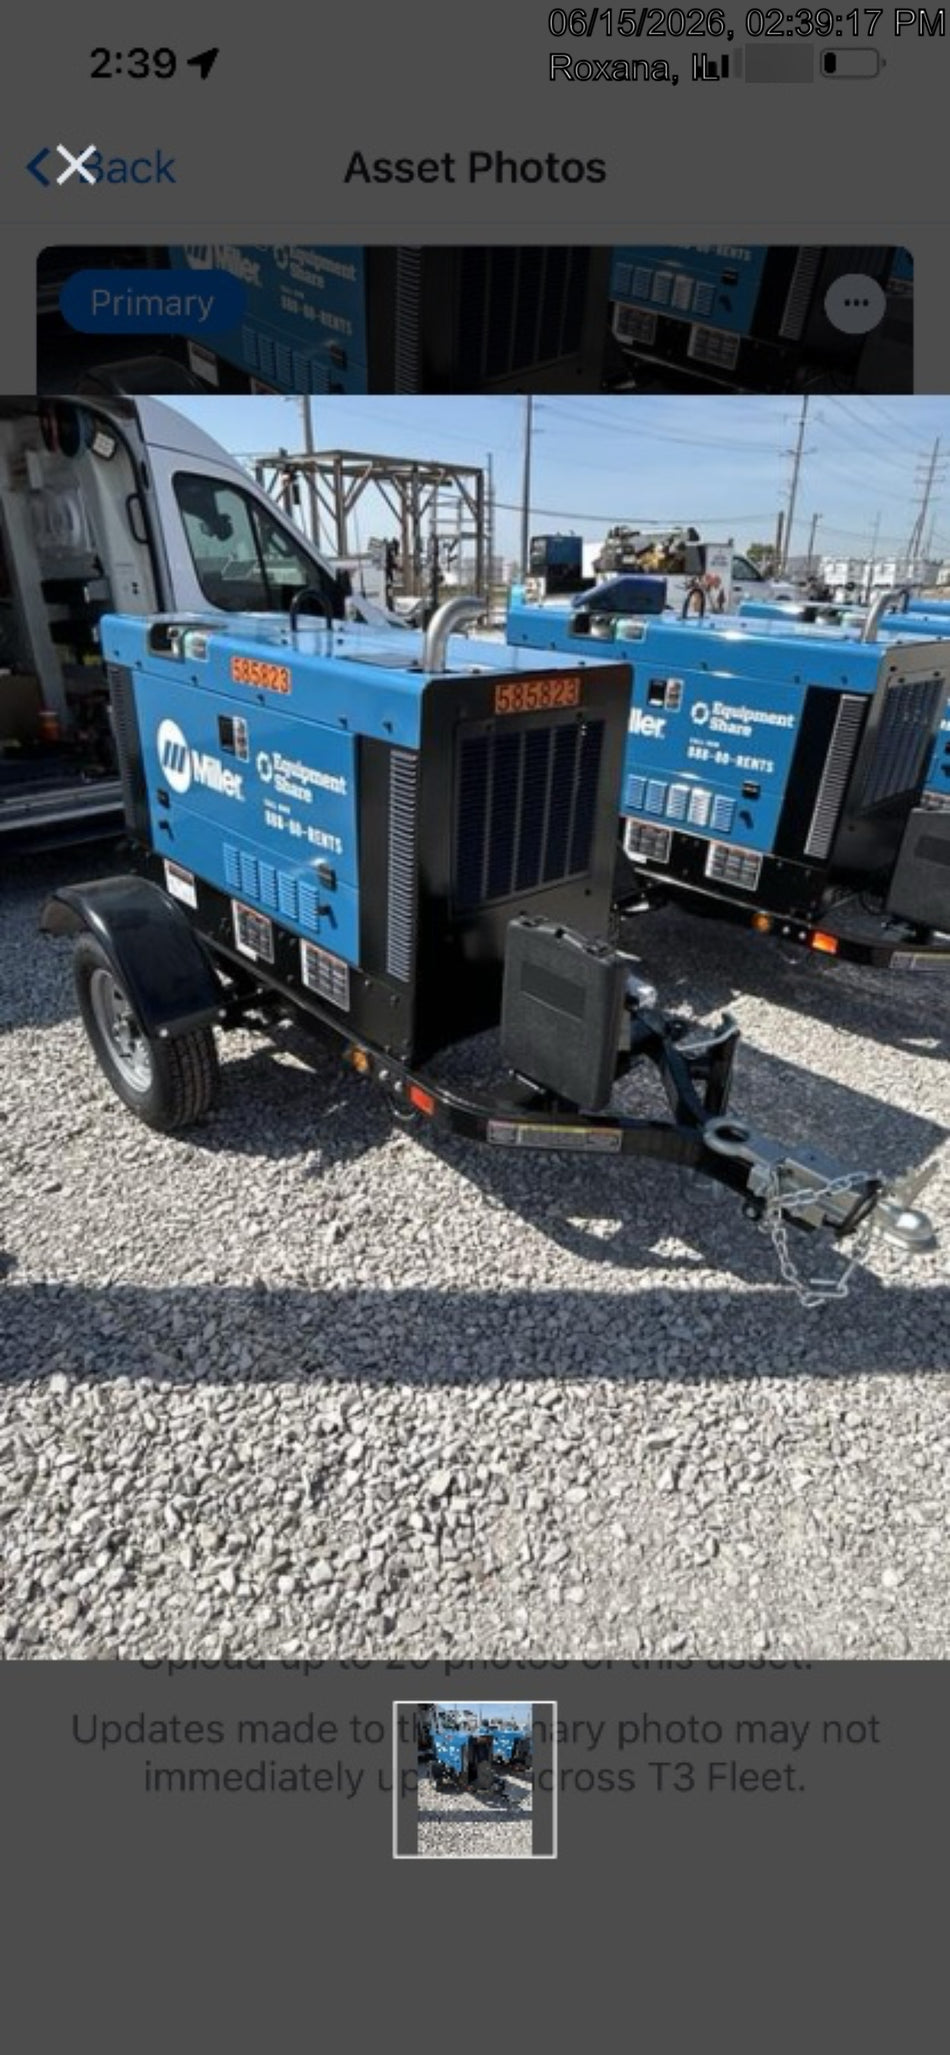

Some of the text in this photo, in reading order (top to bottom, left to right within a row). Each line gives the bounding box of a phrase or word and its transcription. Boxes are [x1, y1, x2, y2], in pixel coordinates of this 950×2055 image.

[90, 47, 176, 79] 2:39
[343, 150, 607, 184] Asset Photos
[92, 287, 215, 322] Primary
[497, 679, 577, 711] 585823
[709, 716, 752, 738] Share
[711, 701, 795, 728] Equipment
[272, 752, 348, 796] Equipment
[273, 774, 313, 804] Share
[72, 1712, 225, 1750] Updates
[239, 1712, 339, 1744] made
[350, 1715, 385, 1744] to
[619, 1712, 723, 1750] photo
[737, 1720, 811, 1751] may
[824, 1716, 881, 1744] not
[146, 1760, 364, 1799] immediately
[531, 1768, 636, 1792] cross
[648, 1762, 695, 1792] T3
[709, 1761, 805, 1792] Fleet.
